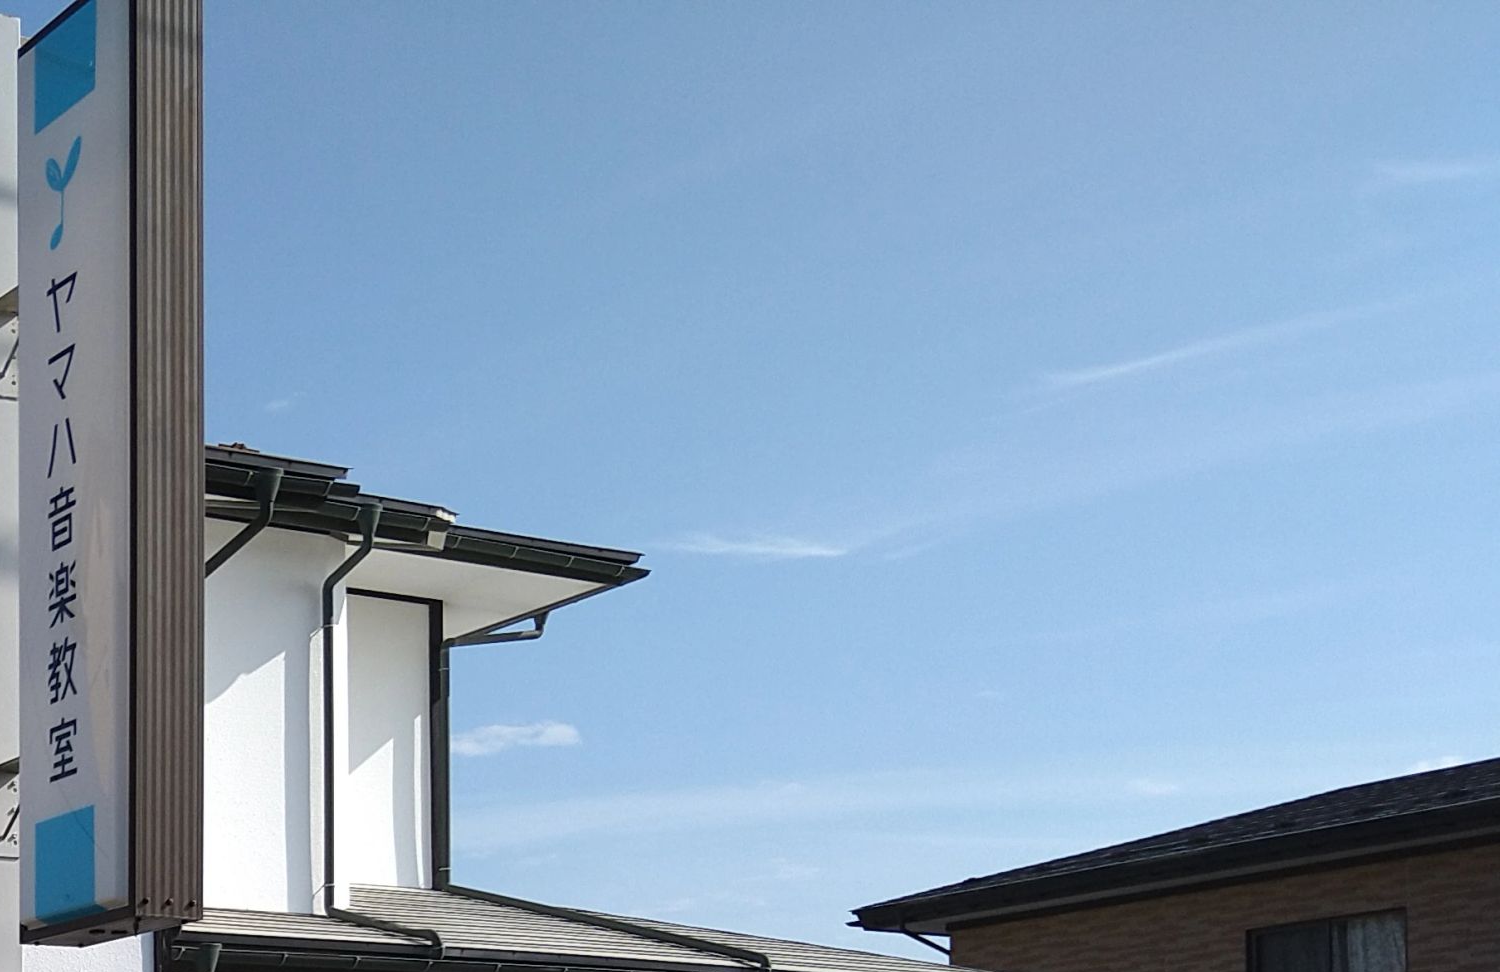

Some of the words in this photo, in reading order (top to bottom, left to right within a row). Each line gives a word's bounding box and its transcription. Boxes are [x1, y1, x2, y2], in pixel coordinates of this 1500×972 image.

[45, 270, 78, 783] ヤマハ音楽教室
